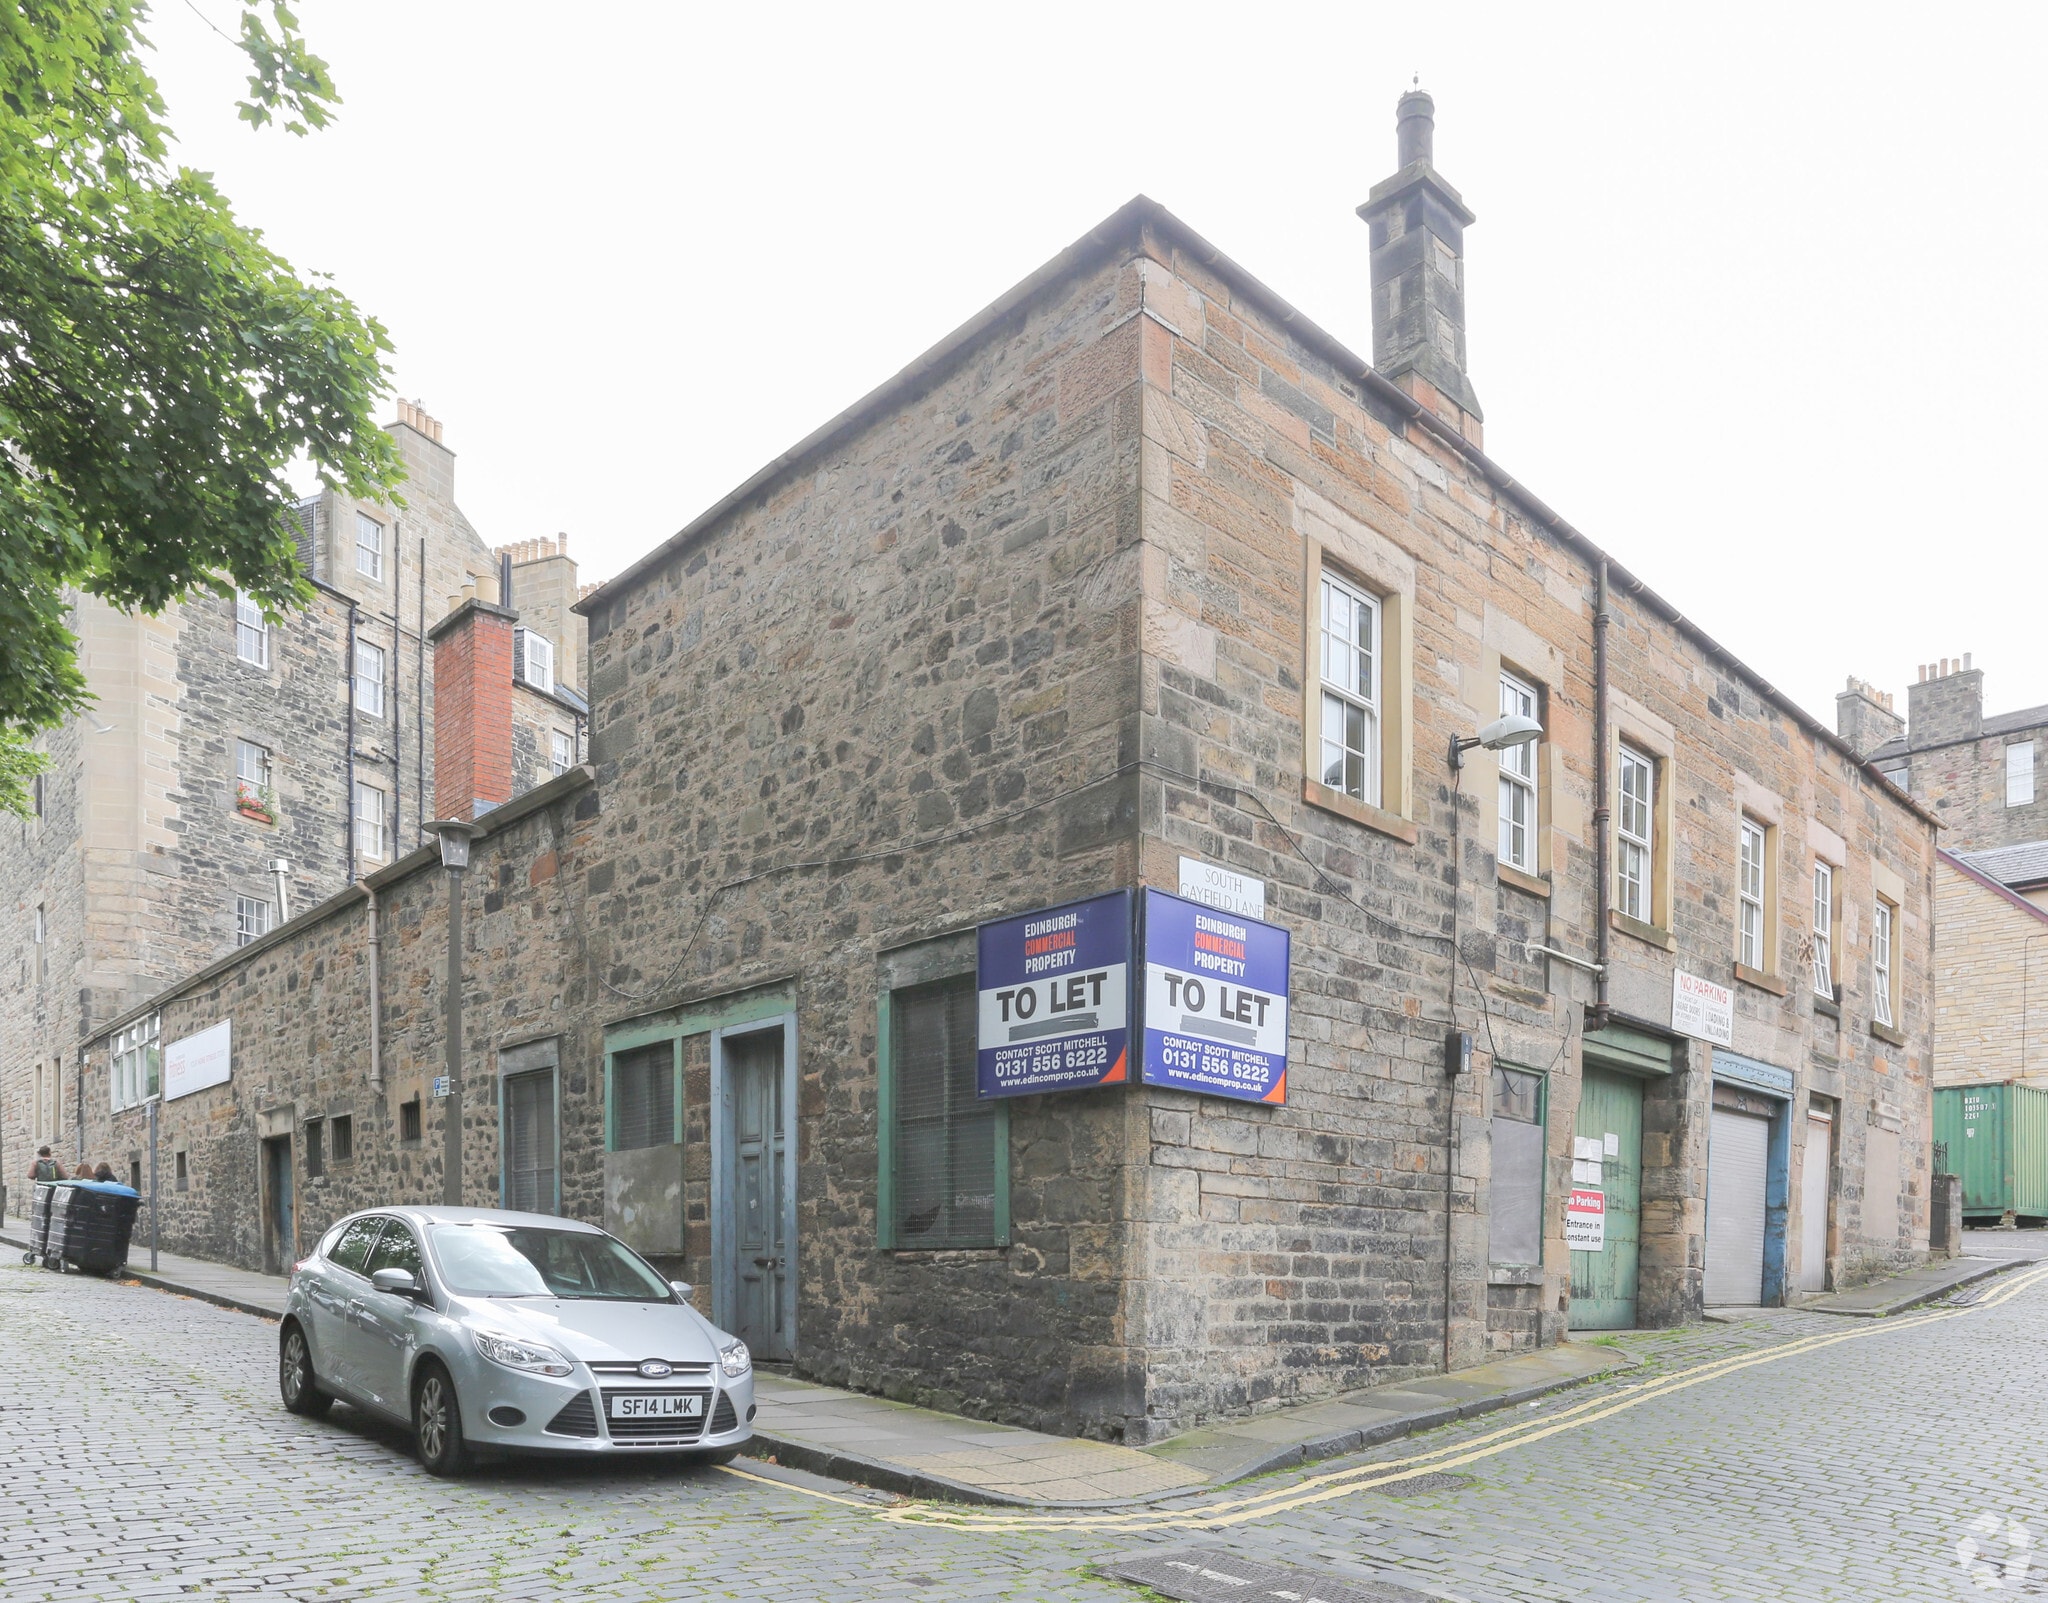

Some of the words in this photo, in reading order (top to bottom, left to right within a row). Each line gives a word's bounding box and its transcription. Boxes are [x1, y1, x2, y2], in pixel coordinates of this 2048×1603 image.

[1205, 868, 1242, 893] SOUTH
[1180, 882, 1232, 910] GAYFIELD
[1235, 897, 1263, 919] LANE
[1025, 913, 1077, 938] EDINBURGH
[1195, 914, 1247, 942] EDINBURGH
[1025, 930, 1076, 956] COMMERCIAL
[1194, 931, 1246, 960] COMMERCIAL
[1025, 949, 1076, 974] PROPERTY
[1194, 950, 1246, 977] PROPERTY
[996, 986, 1037, 1022] TO
[1050, 971, 1107, 1014] LET
[1164, 972, 1205, 1012] TO
[1220, 986, 1270, 1027] LET
[1680, 975, 1692, 991] NO
[1693, 980, 1727, 1005] PARKING
[1704, 1024, 1729, 1041] UNLOADING
[1705, 1011, 1726, 1027] LOADING
[1726, 1017, 1729, 1029] &
[996, 1047, 1033, 1060] CONTACT
[1035, 1043, 1062, 1055] SCOTT
[1064, 1036, 1107, 1051] MITCHELL
[1163, 1036, 1202, 1052] CONTACT
[1204, 1044, 1230, 1058] SCOTT
[1231, 1050, 1270, 1066] MITCHELL
[995, 1059, 1027, 1077] 0131
[1032, 1054, 1060, 1073] 556
[1066, 1047, 1107, 1068] 6222
[1162, 1048, 1197, 1069] 0131
[1201, 1055, 1229, 1076] 556
[1233, 1062, 1269, 1083] 6222
[1000, 1066, 1099, 1087] www.edincomprop.co.uk
[1168, 1068, 1263, 1092] www.edincomprop.co.uk
[1576, 1195, 1601, 1210] Parking
[1566, 1219, 1593, 1229] Entrance
[1595, 1221, 1600, 1230] in
[622, 1399, 658, 1415] SF14
[662, 1398, 693, 1414] LMK
